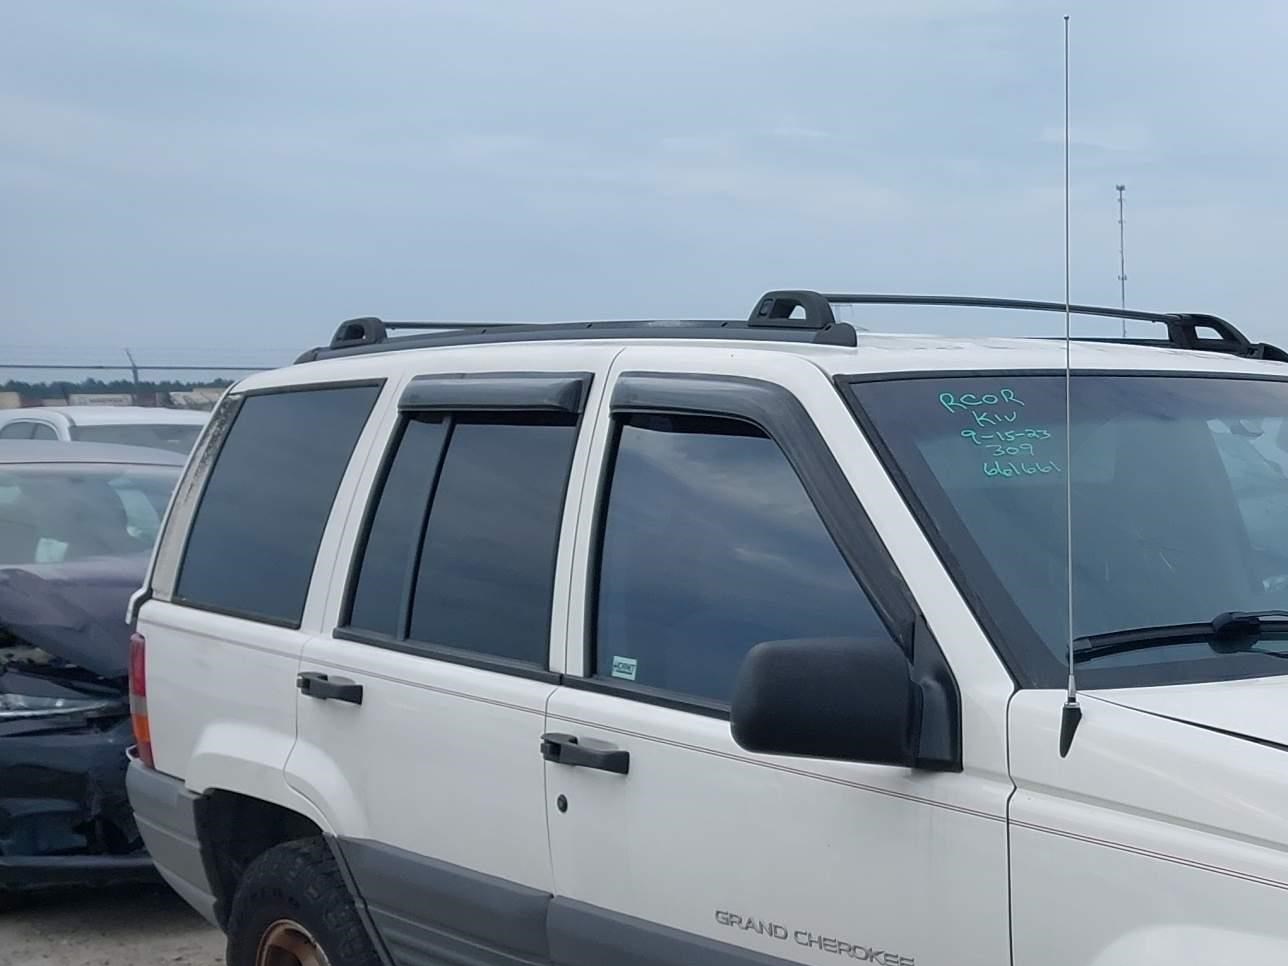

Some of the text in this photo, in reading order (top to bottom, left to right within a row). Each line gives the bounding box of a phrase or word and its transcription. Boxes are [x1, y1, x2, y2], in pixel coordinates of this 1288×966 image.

[939, 388, 1025, 413] RCOR
[960, 428, 1051, 444] 9-15-23
[986, 443, 1034, 456] 309
[714, 909, 789, 941] GRAND
